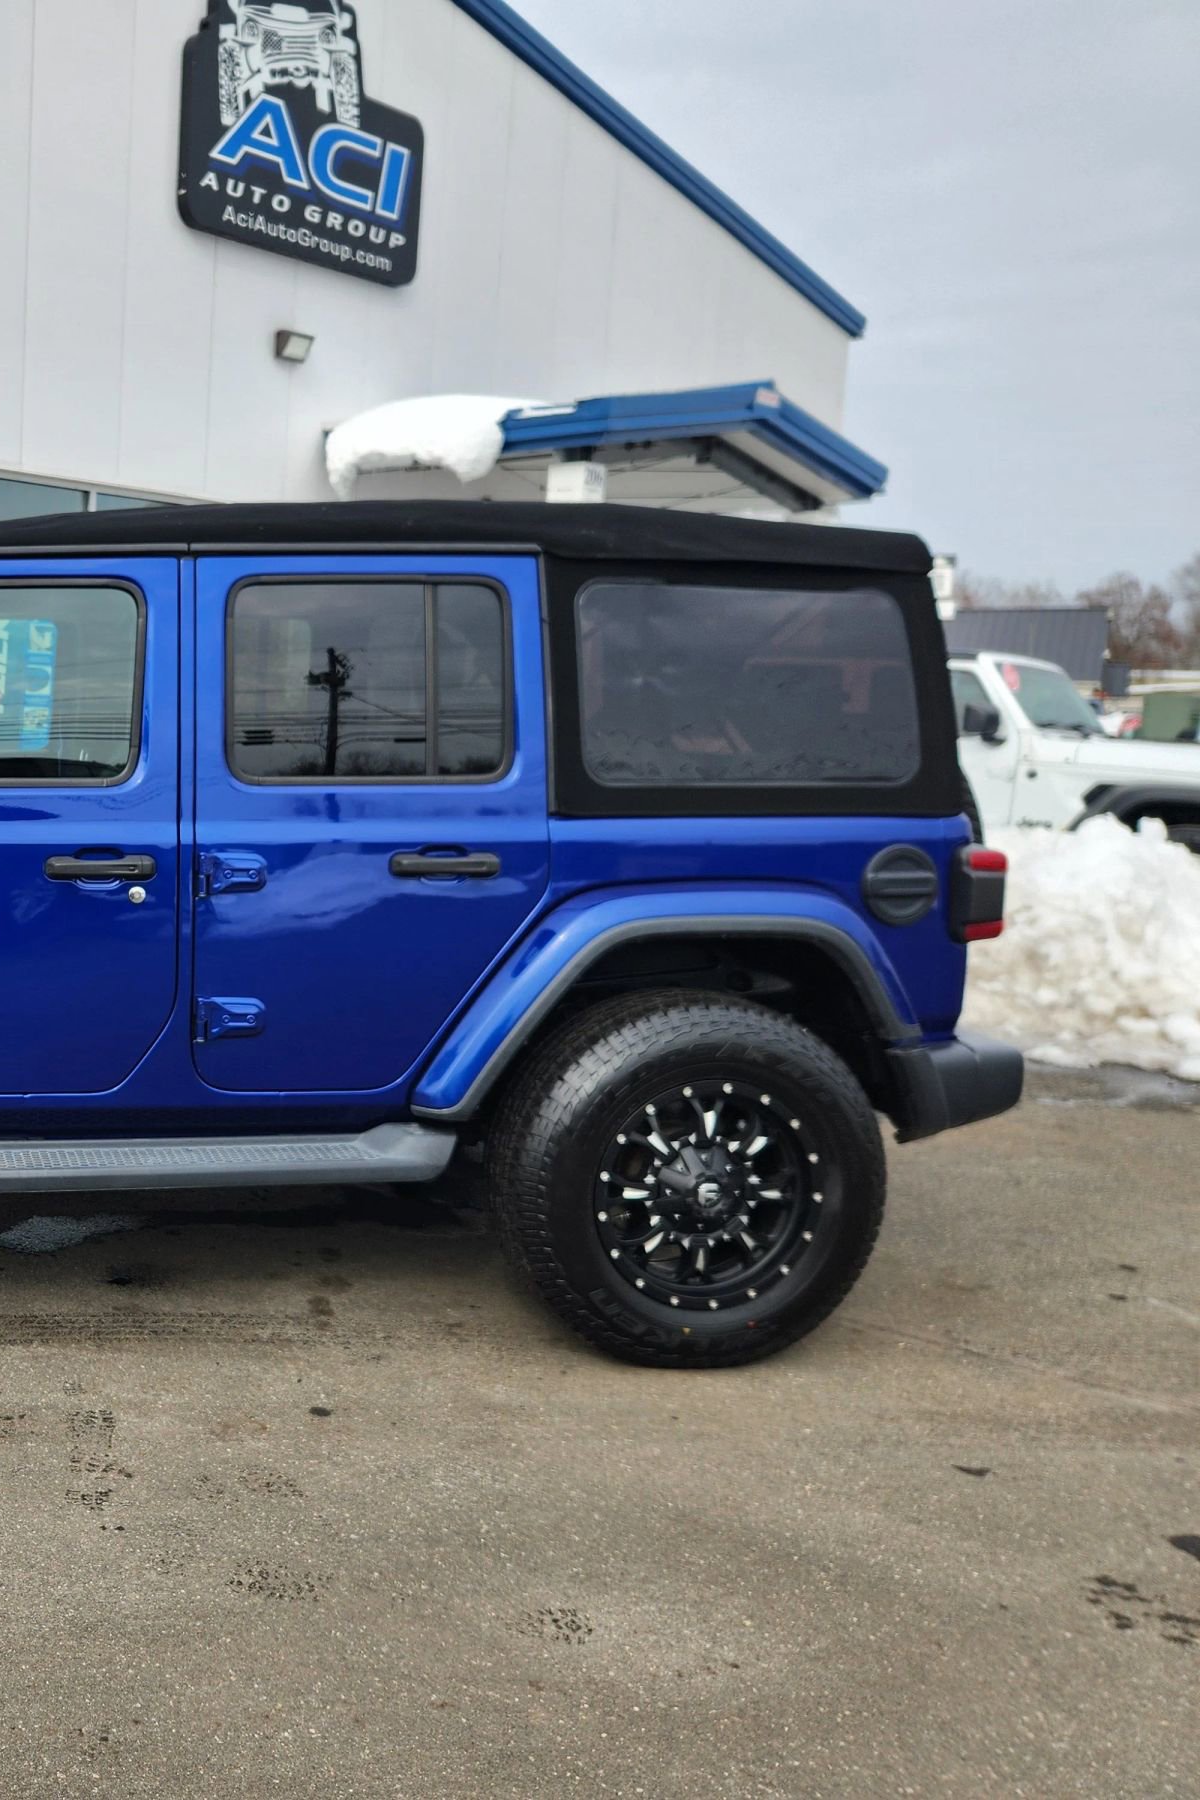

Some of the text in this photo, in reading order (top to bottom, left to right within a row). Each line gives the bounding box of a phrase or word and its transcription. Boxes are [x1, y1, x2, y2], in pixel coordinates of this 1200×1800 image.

[208, 92, 412, 222] ACI
[200, 171, 407, 249] AUTO GROUP
[221, 204, 393, 272] AciAutoGroup.com
